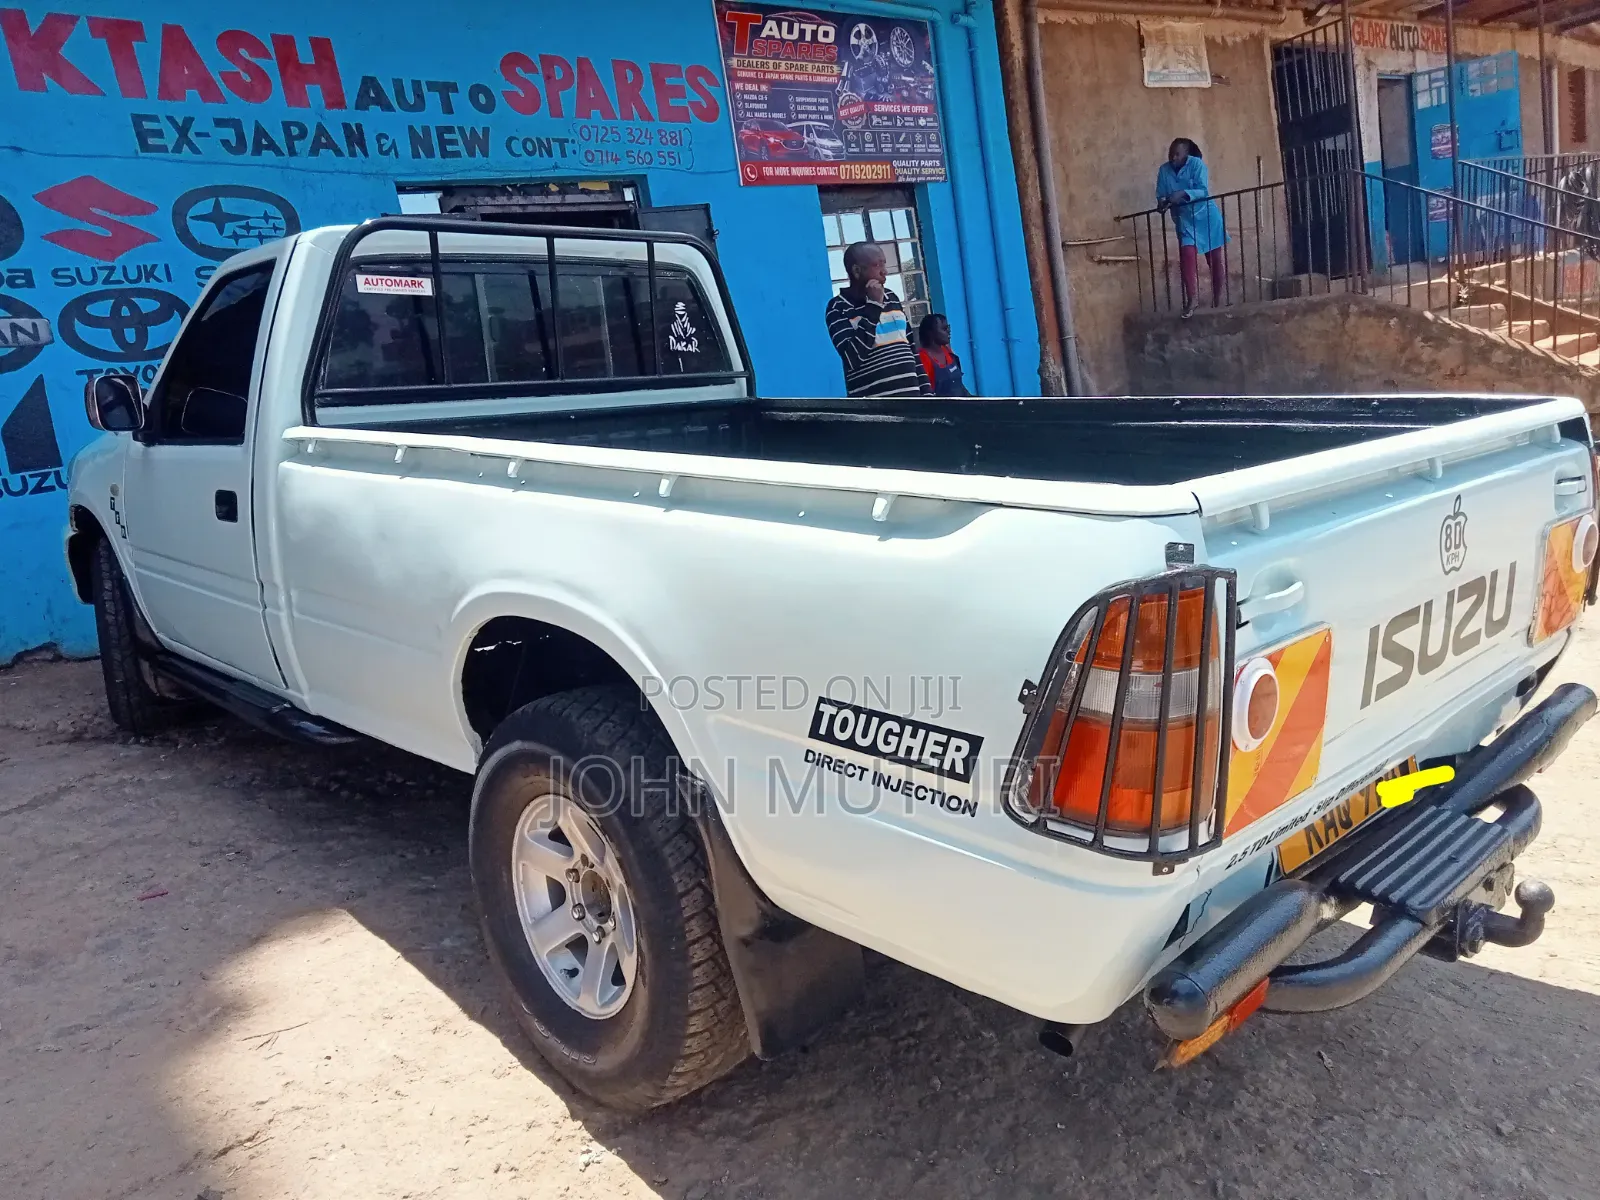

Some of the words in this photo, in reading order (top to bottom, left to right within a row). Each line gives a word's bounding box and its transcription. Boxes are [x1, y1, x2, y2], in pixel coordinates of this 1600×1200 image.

[726, 10, 763, 56] T
[760, 20, 836, 44] AUTO
[1352, 20, 1388, 49] GLORY
[1390, 24, 1420, 52] AUTO
[752, 39, 838, 62] SPARES
[0, 8, 347, 110] KTASH
[500, 52, 721, 124] SPARES
[736, 60, 770, 70] DEALERS
[773, 62, 782, 70] OF
[784, 62, 808, 72] SPARE
[812, 64, 834, 73] PARTS
[850, 104, 864, 114] QUALITY
[874, 104, 900, 112] SERVICES
[130, 113, 370, 159] EX-JAPAN
[408, 125, 490, 160] NEW
[505, 135, 578, 159] CONT:
[580, 124, 621, 144] 0725
[626, 126, 654, 146] 324
[657, 128, 683, 146] 881
[584, 149, 621, 166] 0714
[626, 150, 654, 166] 560
[657, 150, 682, 166] 551
[763, 166, 774, 176] FOR
[774, 166, 790, 176] MORE
[817, 166, 838, 176] CONTACT
[840, 164, 891, 179] 0719202911
[51, 263, 172, 288] SUZUKI
[364, 278, 424, 288] AUTOMARK
[669, 336, 700, 352] DAKAR
[1445, 521, 1462, 553] 80
[1446, 551, 1460, 566] KPH
[1360, 561, 1517, 710] ISUZU
[818, 702, 970, 775] TOUGHER
[804, 748, 869, 782] DIRECT
[872, 770, 978, 818] INJECTION
[1312, 796, 1336, 816] Slip
[1304, 798, 1354, 856] KAQ
